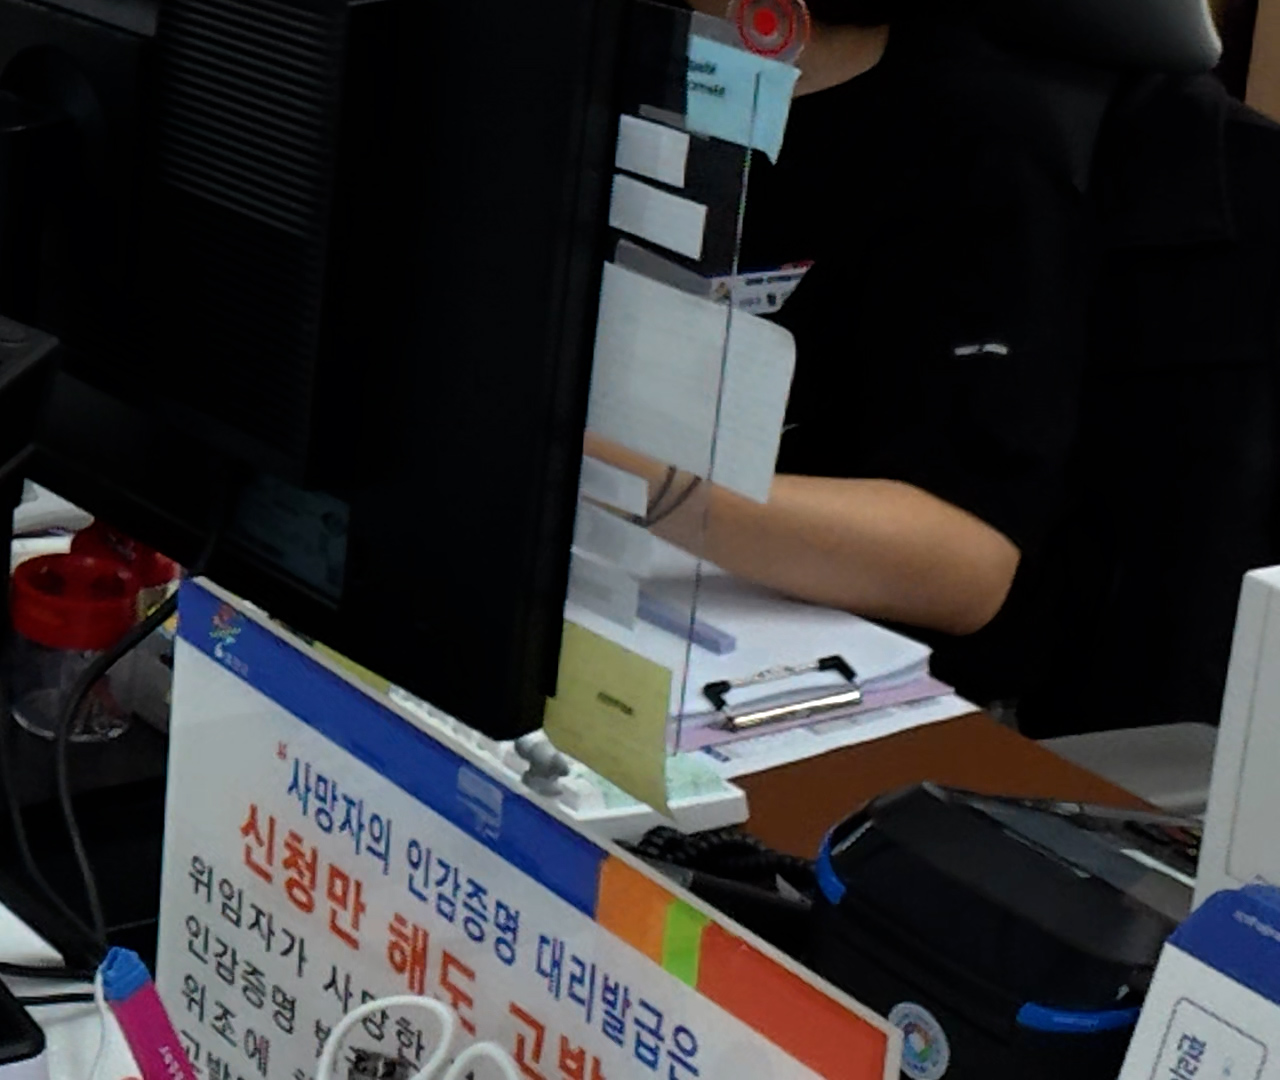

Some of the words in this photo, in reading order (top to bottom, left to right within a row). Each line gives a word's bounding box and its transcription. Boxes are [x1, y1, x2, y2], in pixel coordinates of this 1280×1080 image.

[185, 914, 295, 1034] 인감증명
[189, 855, 308, 977] 위임자가
[240, 803, 367, 950] 신청만
[388, 912, 476, 1035] 해도
[407, 839, 520, 966] 인감증명
[536, 935, 700, 1080] 대리발급은
[182, 973, 269, 1077] 위조에
